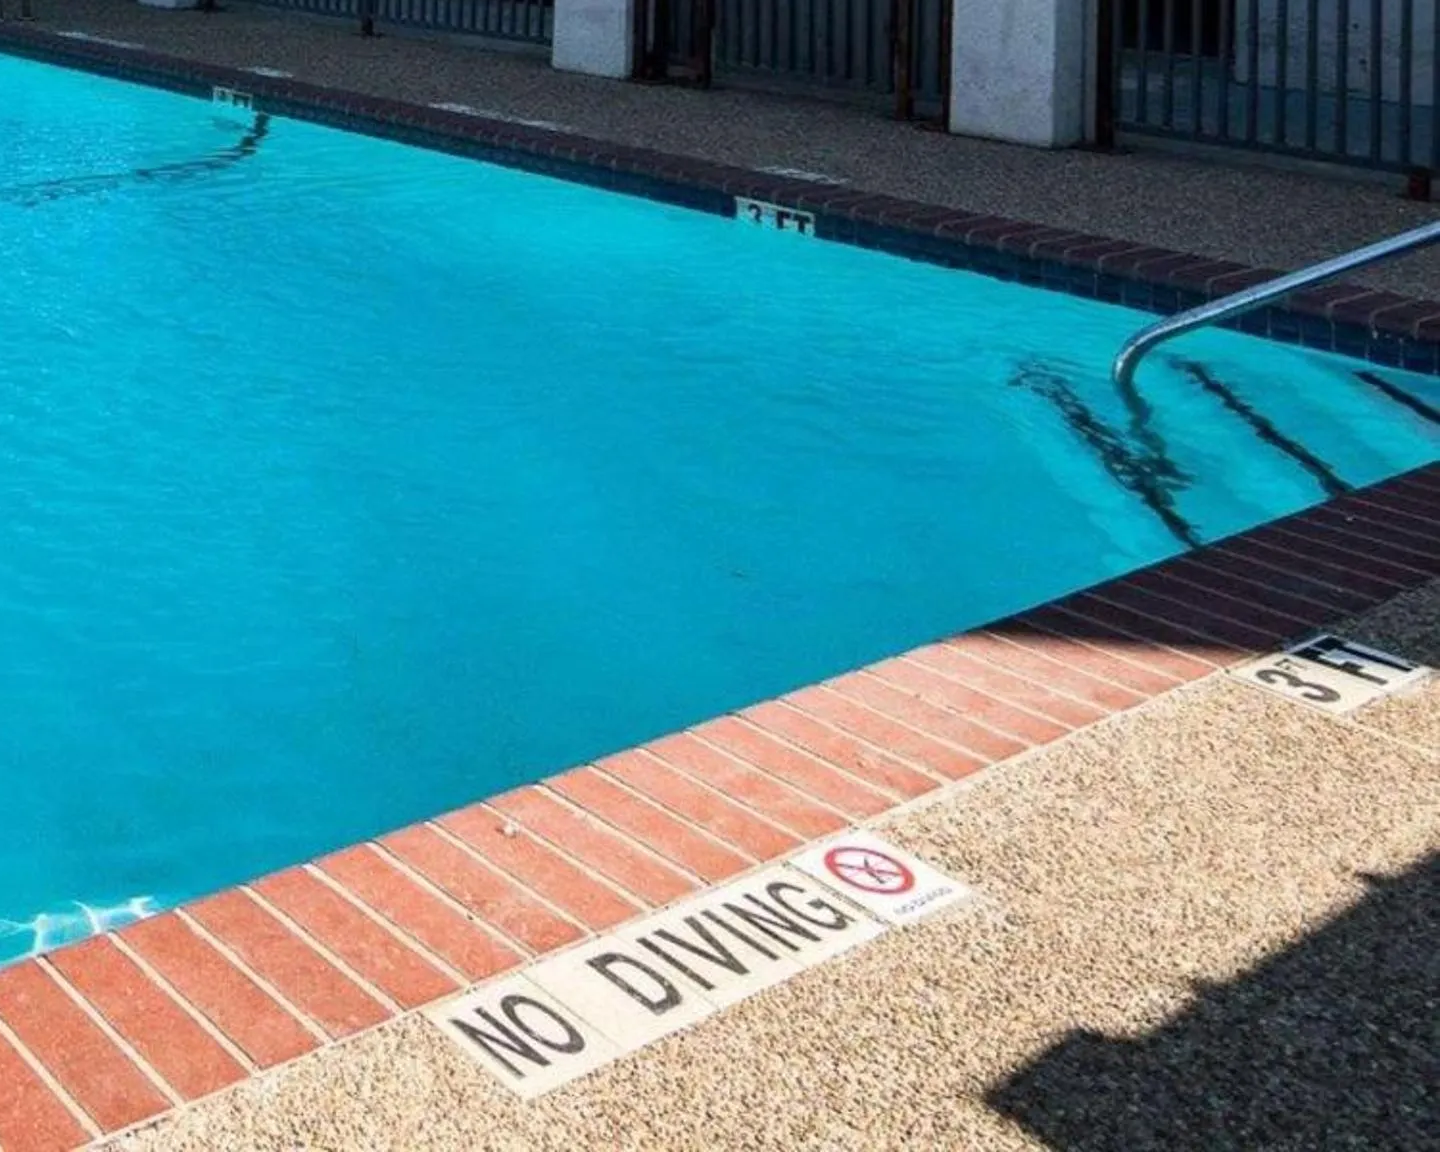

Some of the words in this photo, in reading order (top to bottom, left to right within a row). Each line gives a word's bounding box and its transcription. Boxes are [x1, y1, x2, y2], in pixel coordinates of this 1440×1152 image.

[1293, 637, 1412, 685] FT
[1257, 670, 1340, 702] 3
[448, 992, 586, 1079] NO
[587, 880, 855, 1017] DIVING
